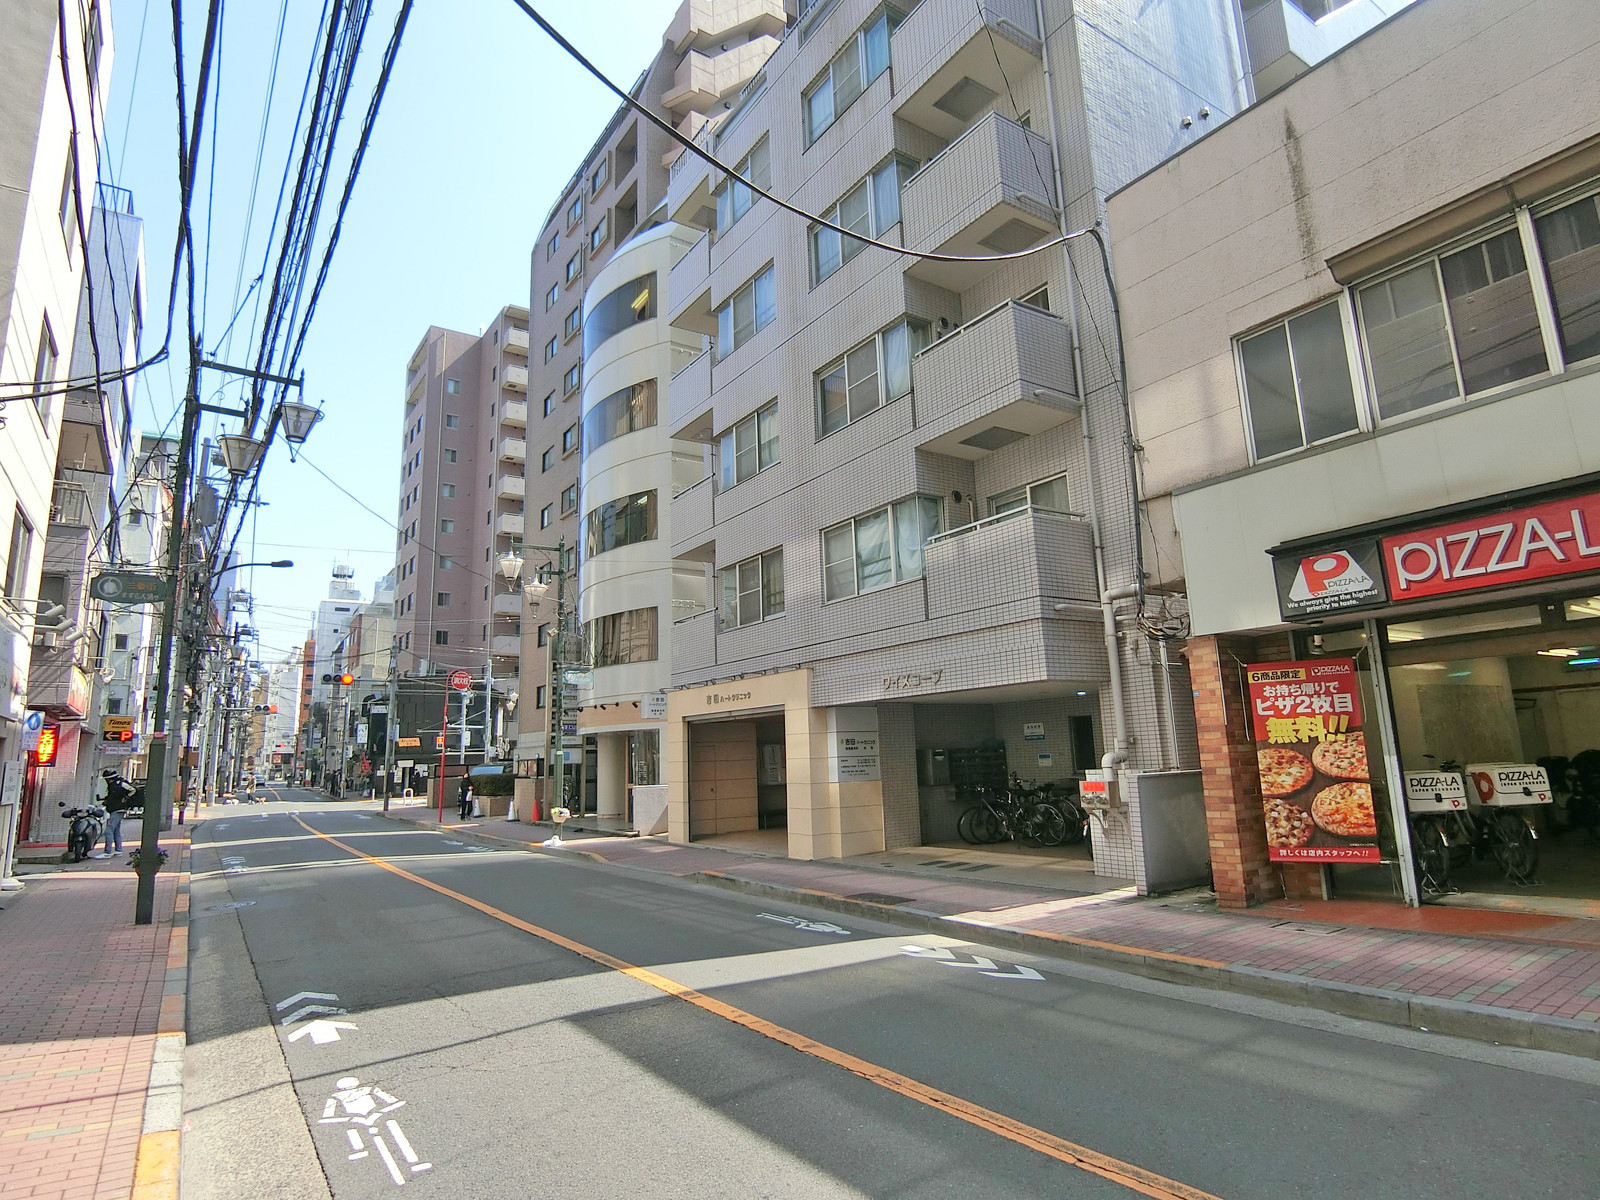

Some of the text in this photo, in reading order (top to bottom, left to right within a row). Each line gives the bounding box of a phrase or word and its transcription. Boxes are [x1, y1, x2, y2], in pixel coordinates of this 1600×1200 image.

[1327, 575, 1370, 588] PIZZA-LA
[1299, 598, 1324, 608] always
[1324, 596, 1339, 605] give
[1352, 588, 1378, 599] highest
[1306, 603, 1331, 613] priority
[1251, 670, 1301, 682] 6商品限定
[1262, 681, 1340, 697] お持ち帰りで
[1255, 693, 1353, 716] ピザ2枚目
[1265, 714, 1350, 745] 無料!!
[121, 731, 133, 741] P
[1409, 776, 1460, 788] PIZZA-LA
[1498, 770, 1545, 782] PIZZA-LA
